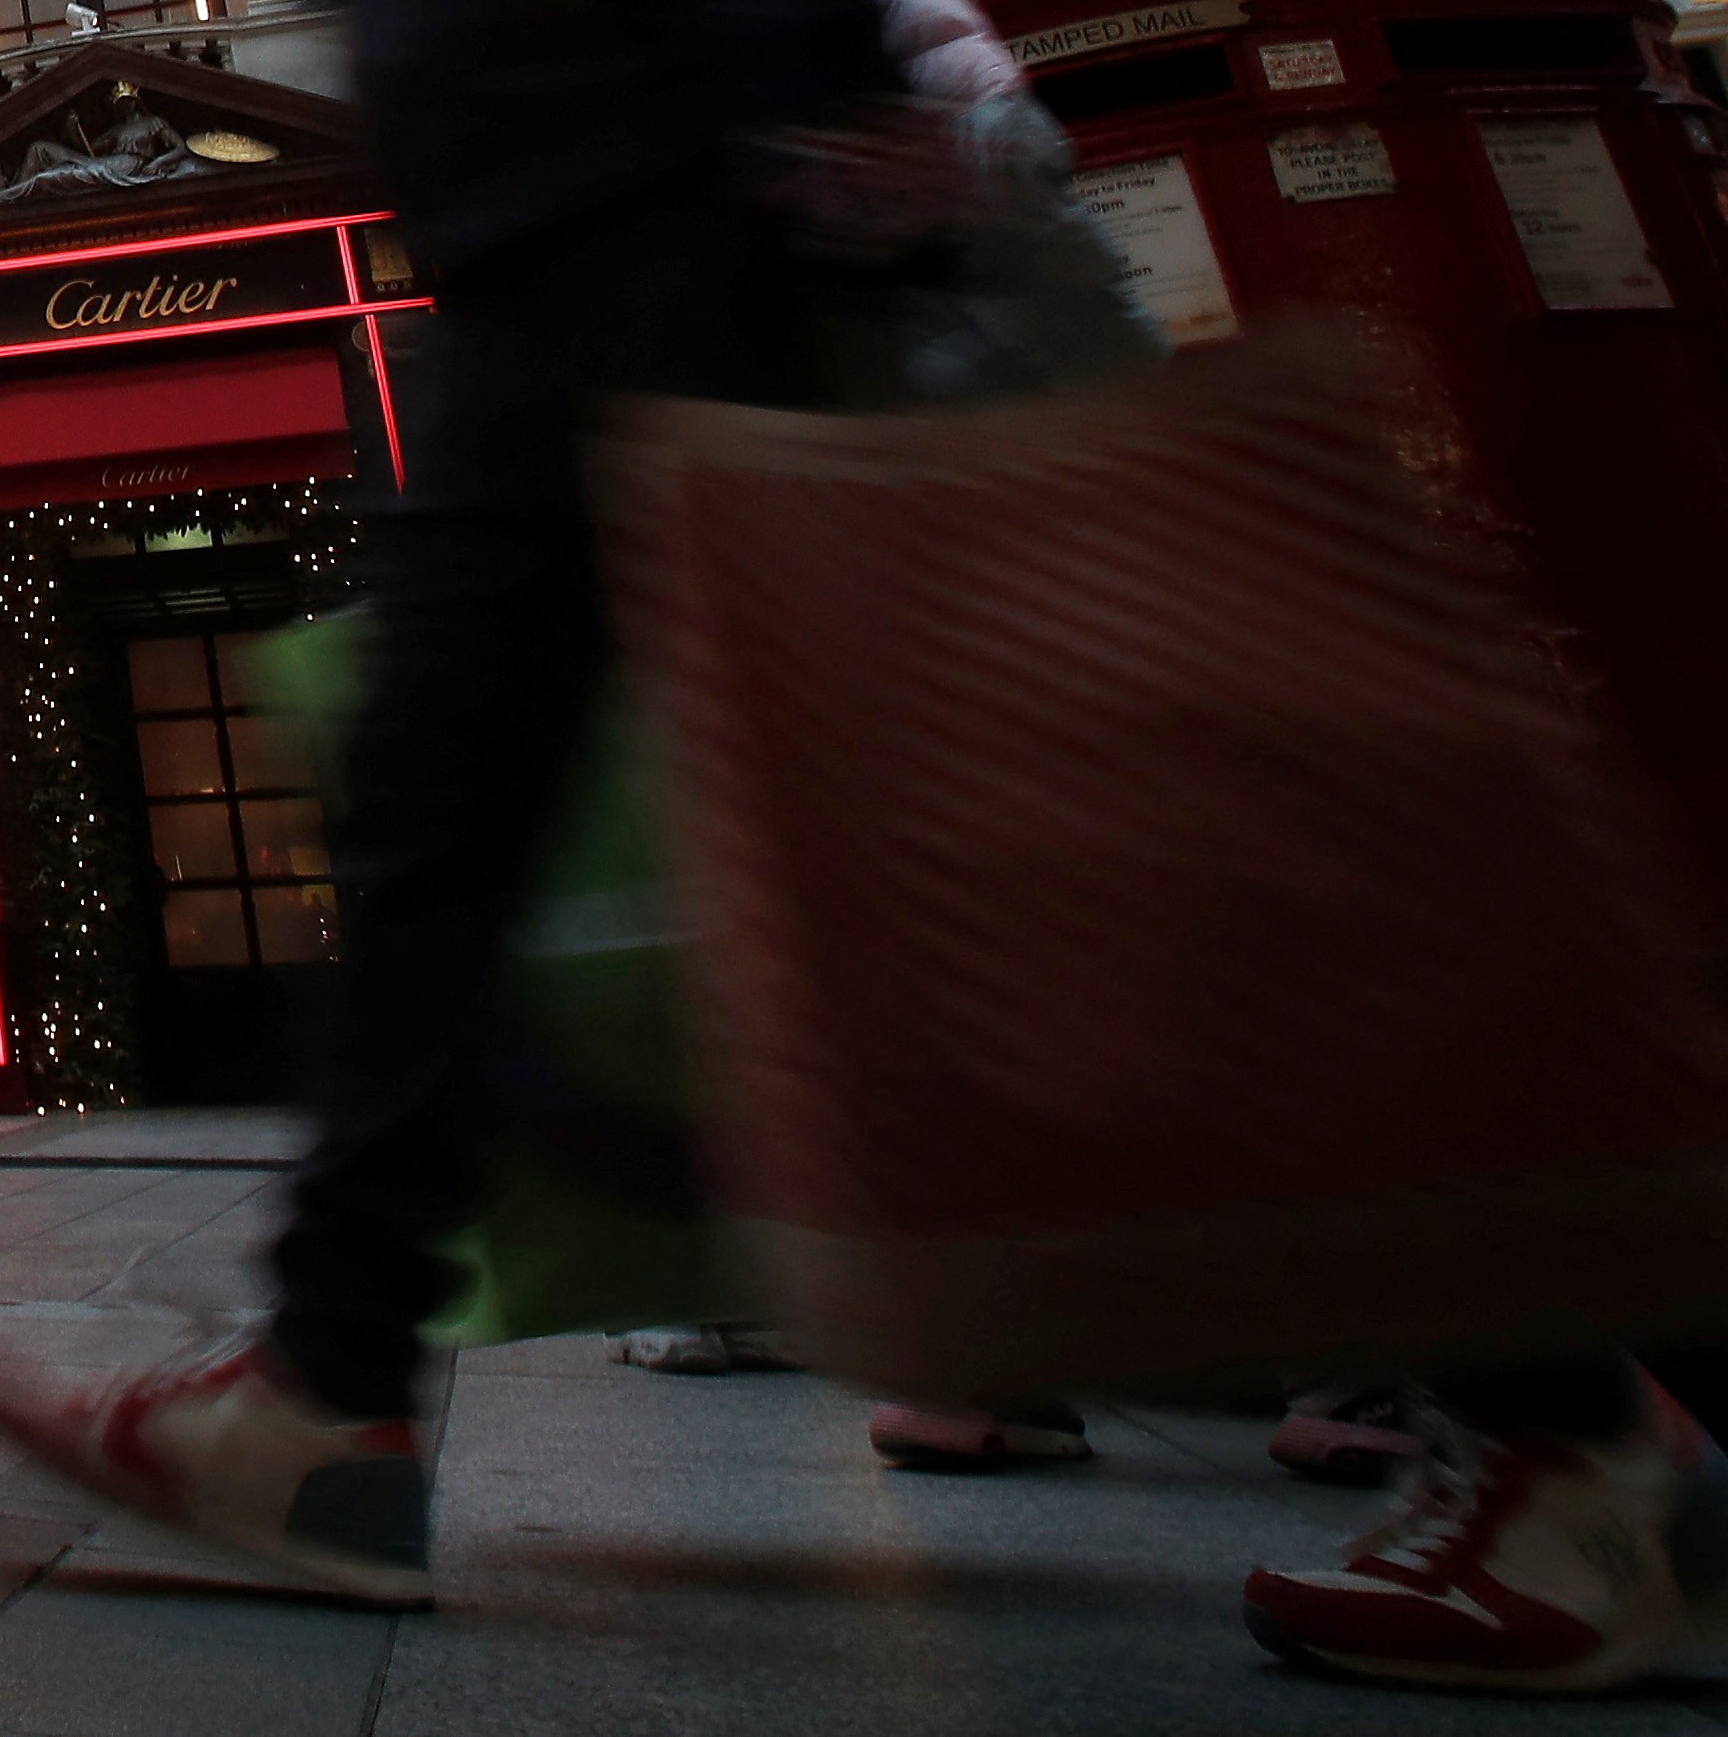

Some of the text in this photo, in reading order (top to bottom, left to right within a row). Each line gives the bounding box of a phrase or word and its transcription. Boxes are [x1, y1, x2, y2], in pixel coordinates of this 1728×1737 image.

[1005, 7, 1205, 63] TAMPED MAIL
[45, 275, 238, 330] Cartier
[100, 463, 190, 488] Cartier
